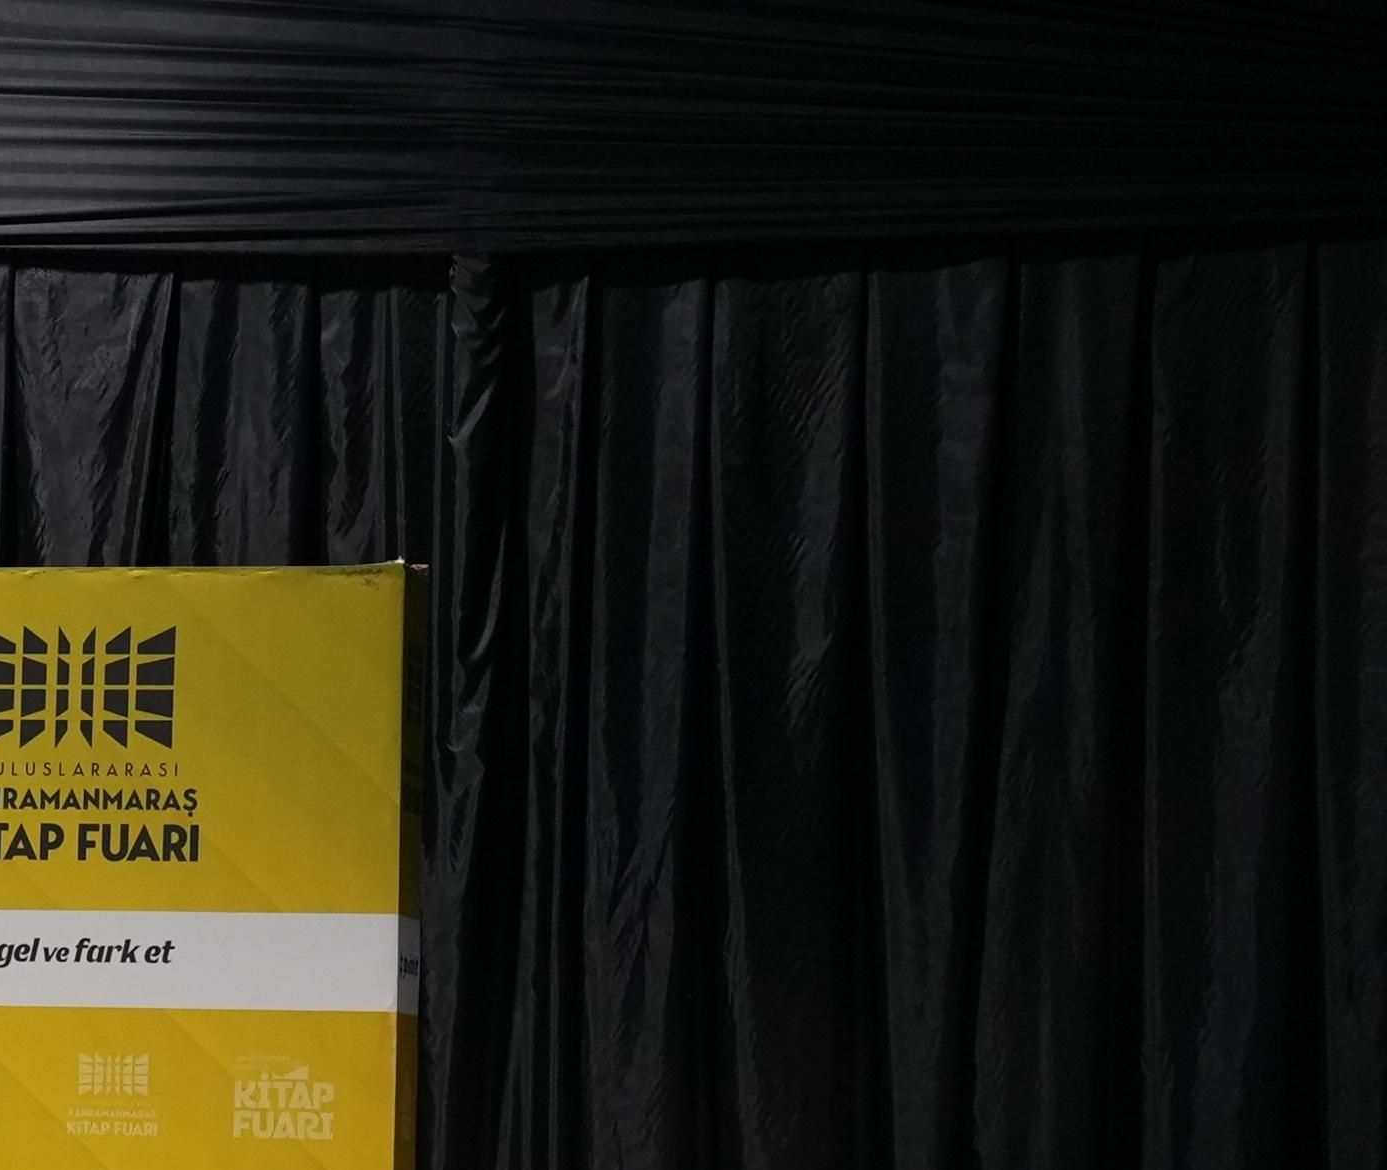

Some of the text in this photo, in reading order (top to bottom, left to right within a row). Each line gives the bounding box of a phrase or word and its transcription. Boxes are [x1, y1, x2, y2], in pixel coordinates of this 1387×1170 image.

[77, 823, 200, 862] FUARI
[43, 946, 70, 962] ve
[74, 937, 140, 963] fark
[144, 940, 175, 964] et
[233, 1109, 334, 1140] FUARI
